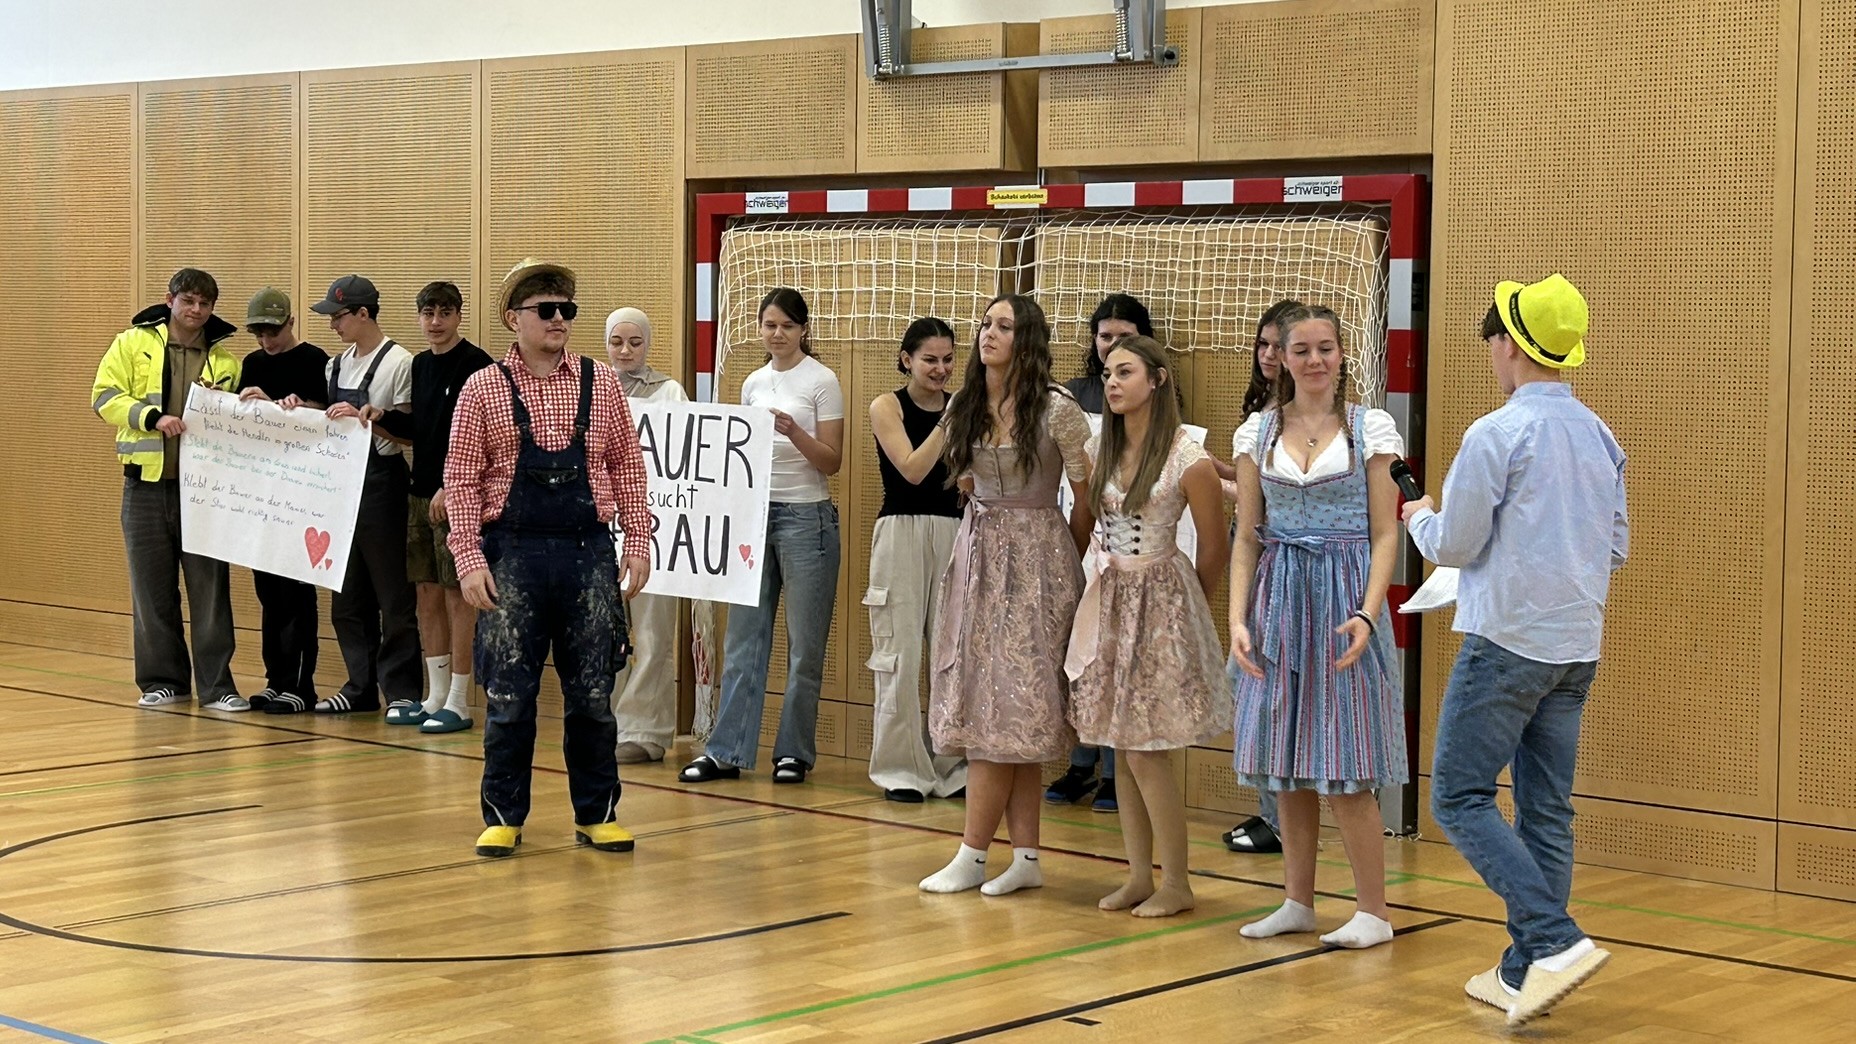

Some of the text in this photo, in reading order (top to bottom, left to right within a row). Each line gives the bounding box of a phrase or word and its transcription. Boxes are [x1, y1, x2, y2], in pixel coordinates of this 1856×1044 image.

[1282, 185, 1344, 197] schweiger
[230, 403, 244, 421] der
[252, 407, 286, 428] Bauer
[293, 424, 318, 434] einen
[284, 440, 311, 454] großen
[637, 412, 753, 488] AUER
[183, 472, 207, 488] Klebt
[212, 480, 225, 492] der
[229, 484, 252, 498] Bauer
[267, 494, 281, 507] der
[189, 493, 206, 505] der
[647, 484, 698, 509] sucht
